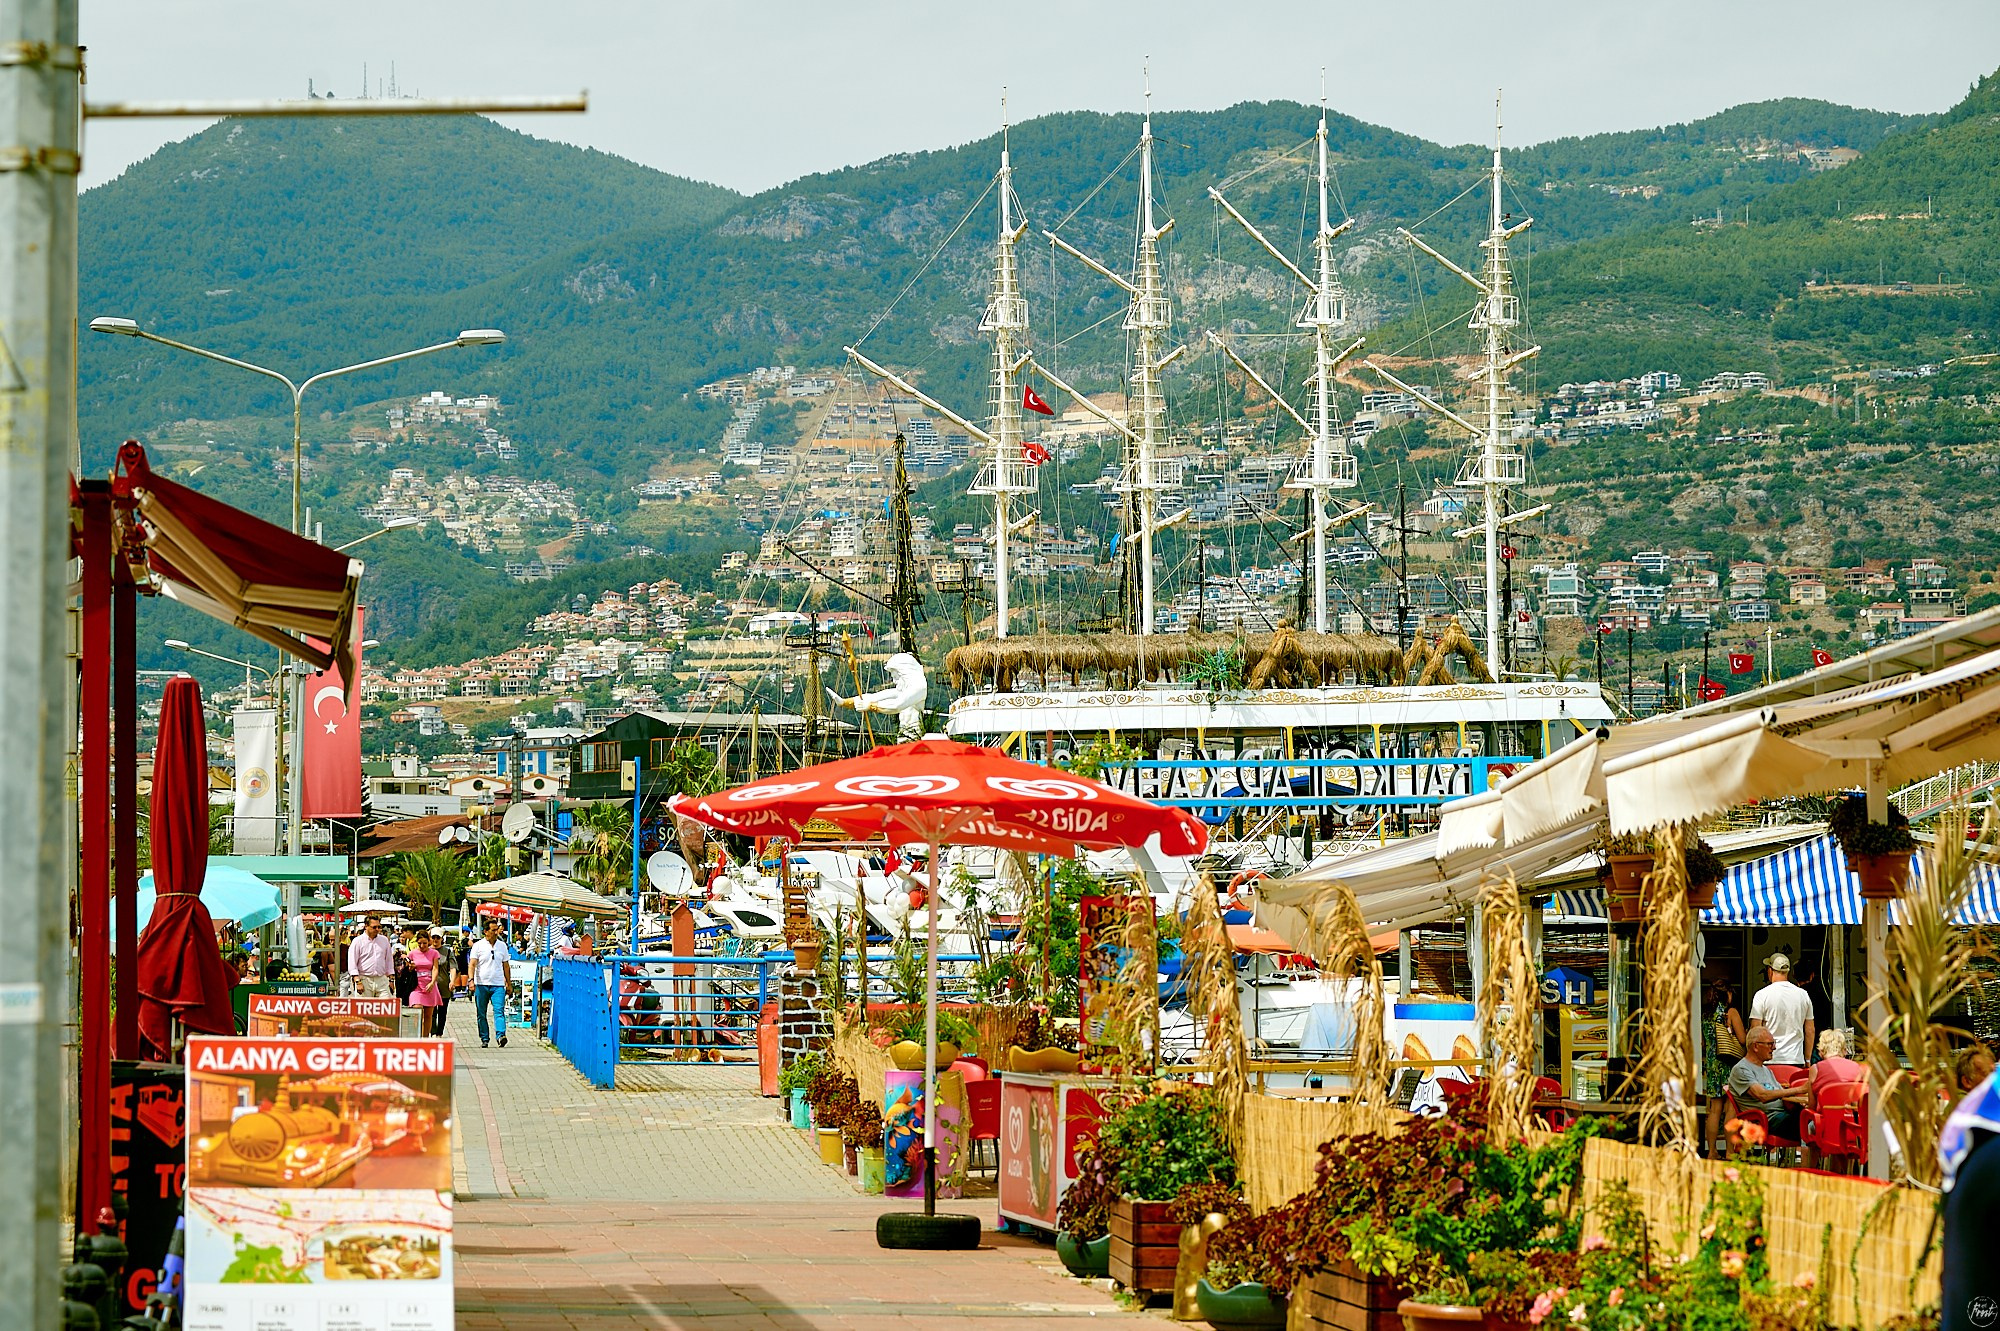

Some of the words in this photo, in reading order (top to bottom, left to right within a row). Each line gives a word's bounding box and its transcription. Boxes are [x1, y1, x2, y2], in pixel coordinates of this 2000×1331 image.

[255, 1000, 313, 1014] ALANYA
[318, 999, 351, 1014] GEZİ
[355, 999, 397, 1016] TRENİ
[198, 1047, 300, 1071] ALANYA
[305, 1043, 366, 1071] GEZİ
[373, 1043, 444, 1071] TRENİ
